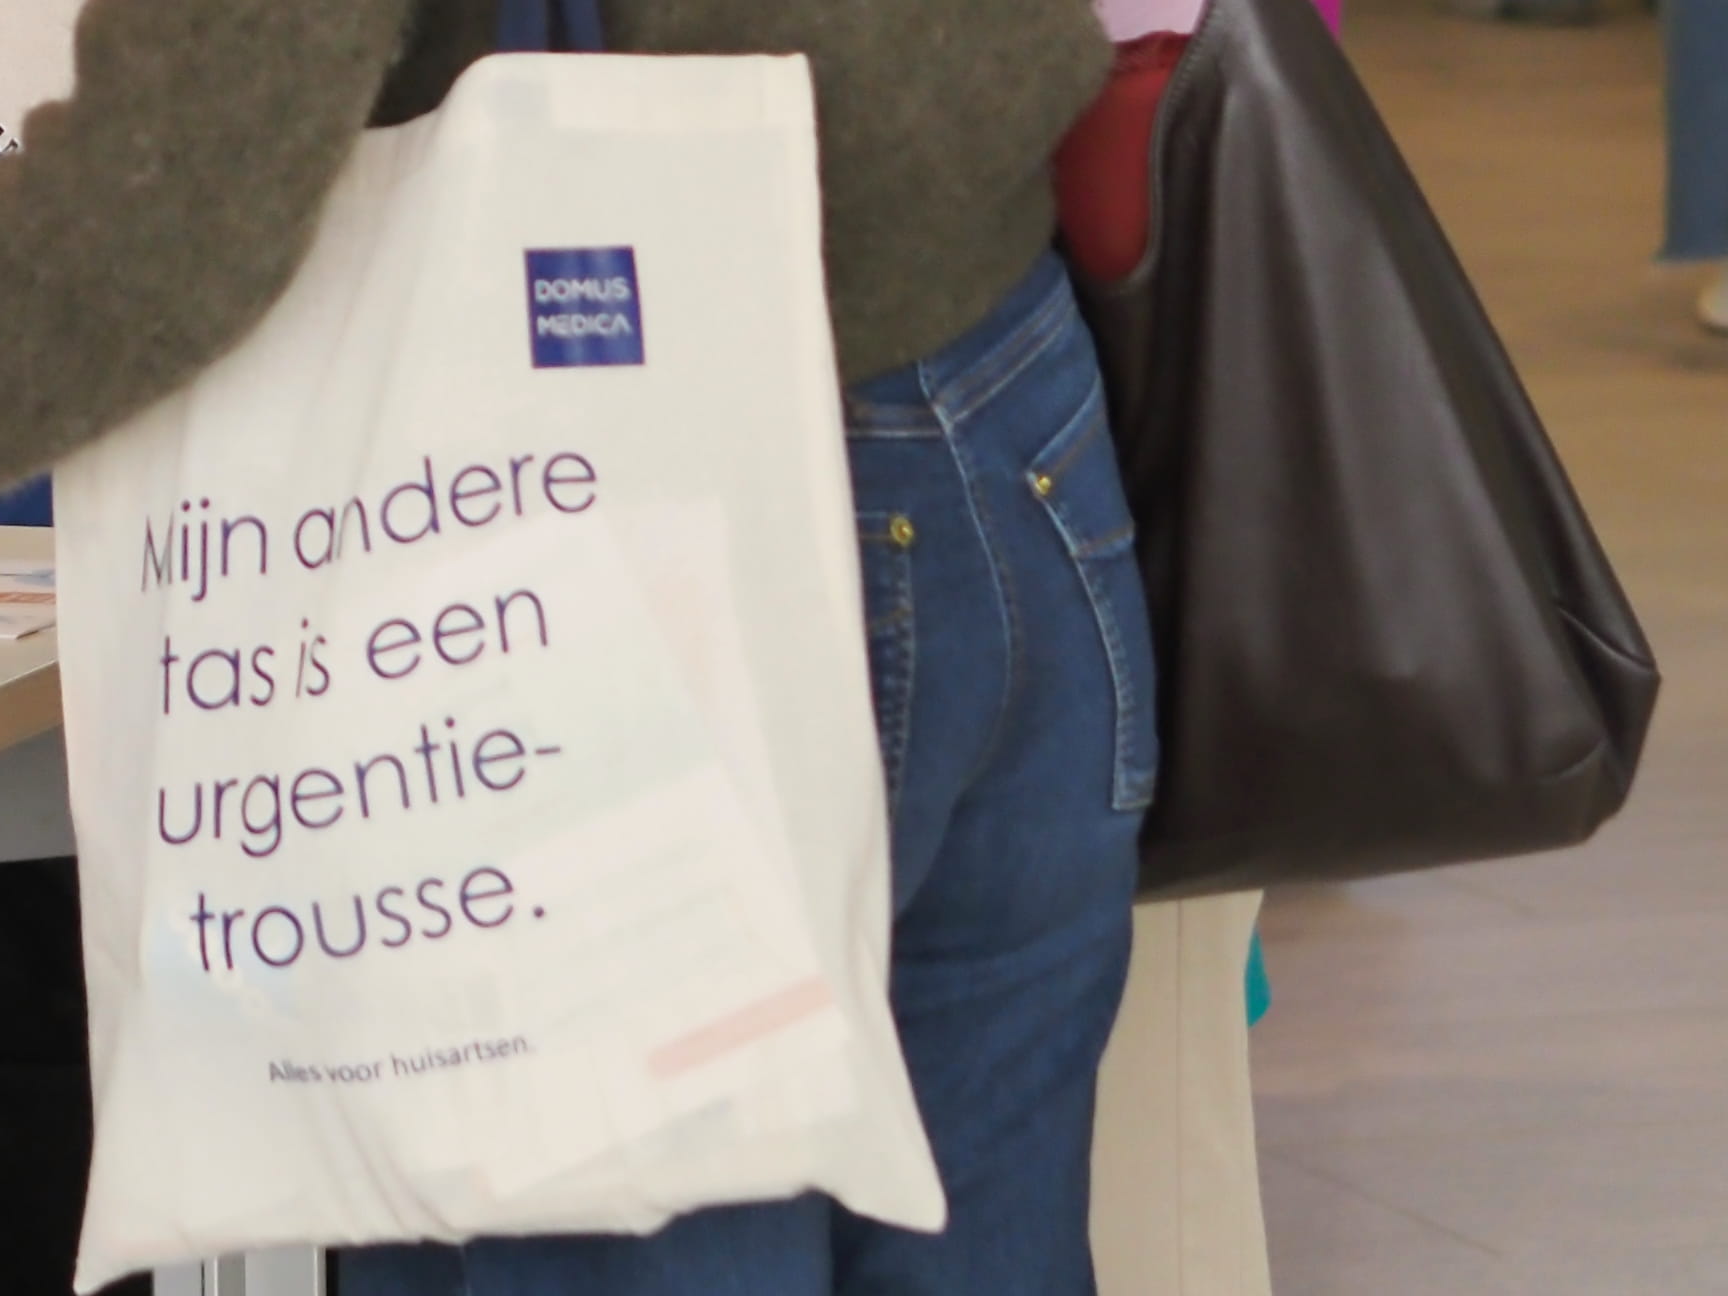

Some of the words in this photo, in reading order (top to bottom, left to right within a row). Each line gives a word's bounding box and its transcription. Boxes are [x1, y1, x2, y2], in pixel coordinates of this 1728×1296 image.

[534, 276, 631, 304] DOMUS
[537, 312, 633, 338] MEDICA
[141, 497, 267, 603] Mijn
[294, 451, 597, 570] andere
[161, 635, 276, 716] tas
[295, 617, 331, 699] is
[366, 589, 549, 680] een
[158, 715, 562, 859] urgentie-
[189, 866, 546, 973] trousse.
[268, 1059, 322, 1083] Alles
[323, 1061, 383, 1084] voor
